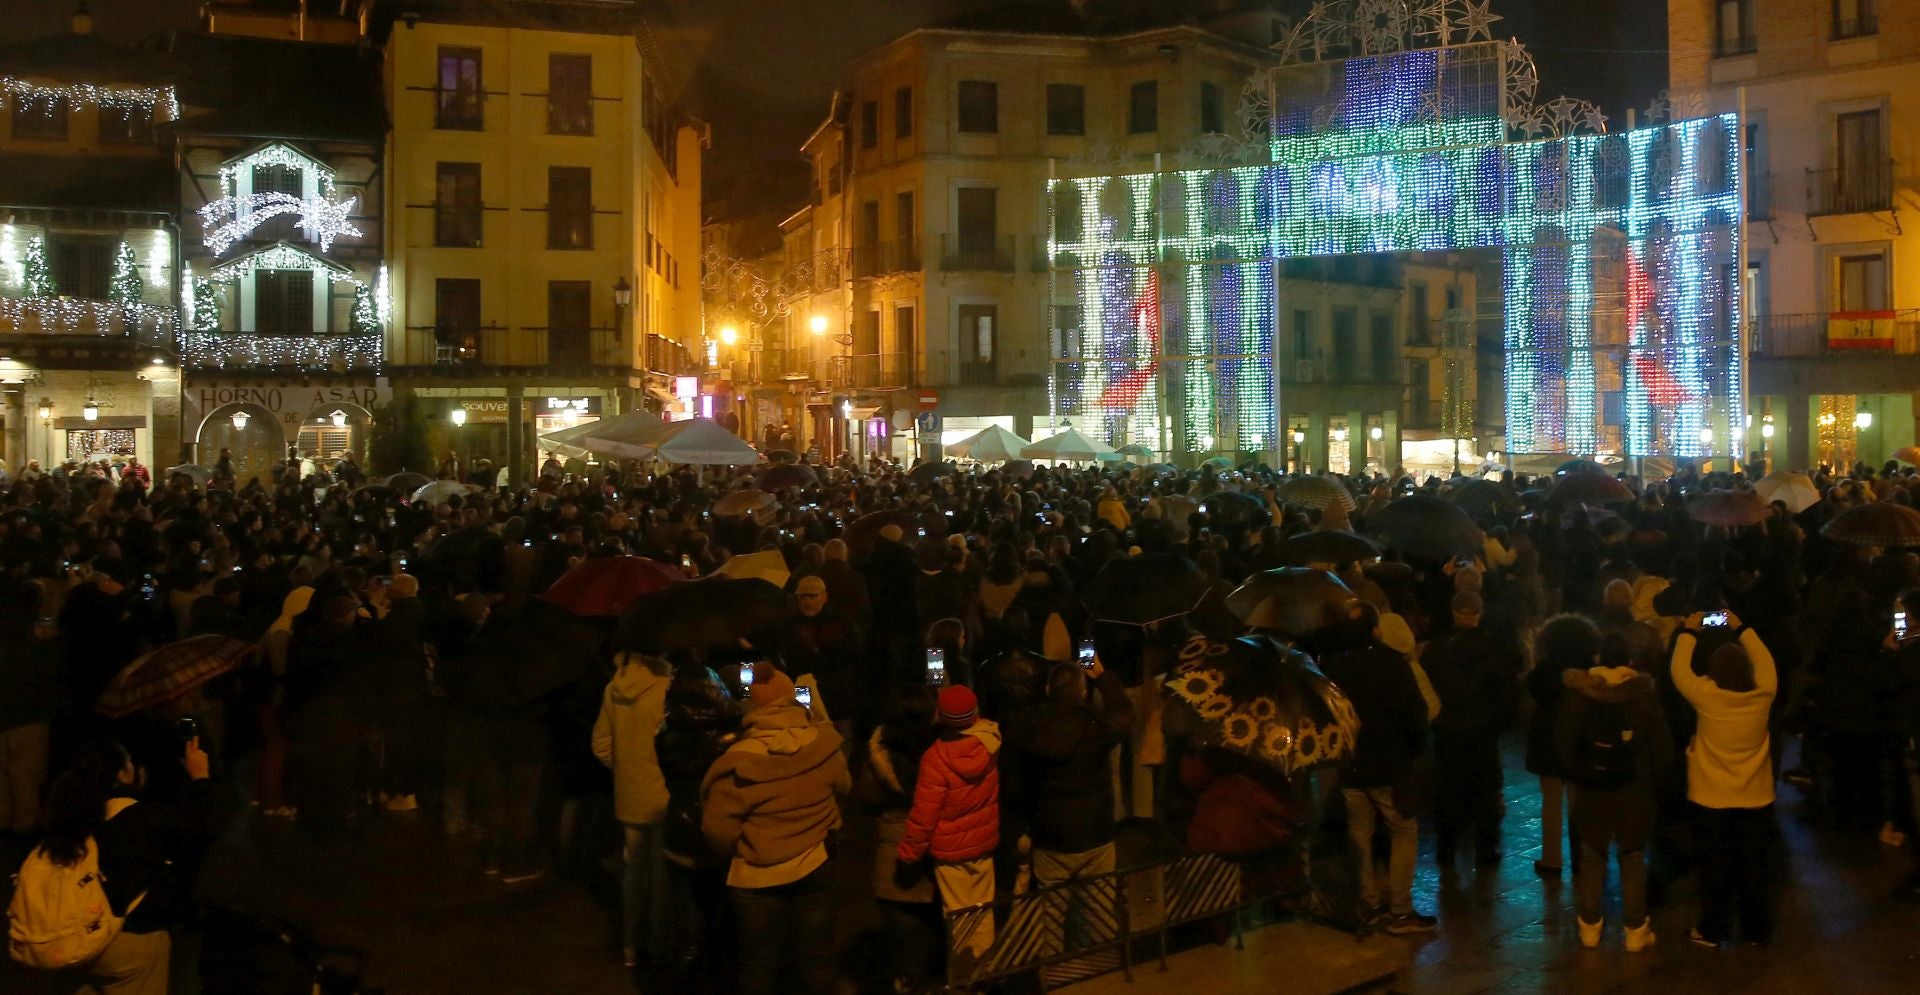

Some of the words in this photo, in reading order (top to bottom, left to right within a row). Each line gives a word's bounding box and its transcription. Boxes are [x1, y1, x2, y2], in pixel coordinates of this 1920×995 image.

[275, 254, 319, 269] CANDID
[200, 388, 282, 419] HORNO
[285, 412, 299, 424] DE
[311, 388, 378, 414] ASAR
[461, 402, 528, 412] SOUVES
